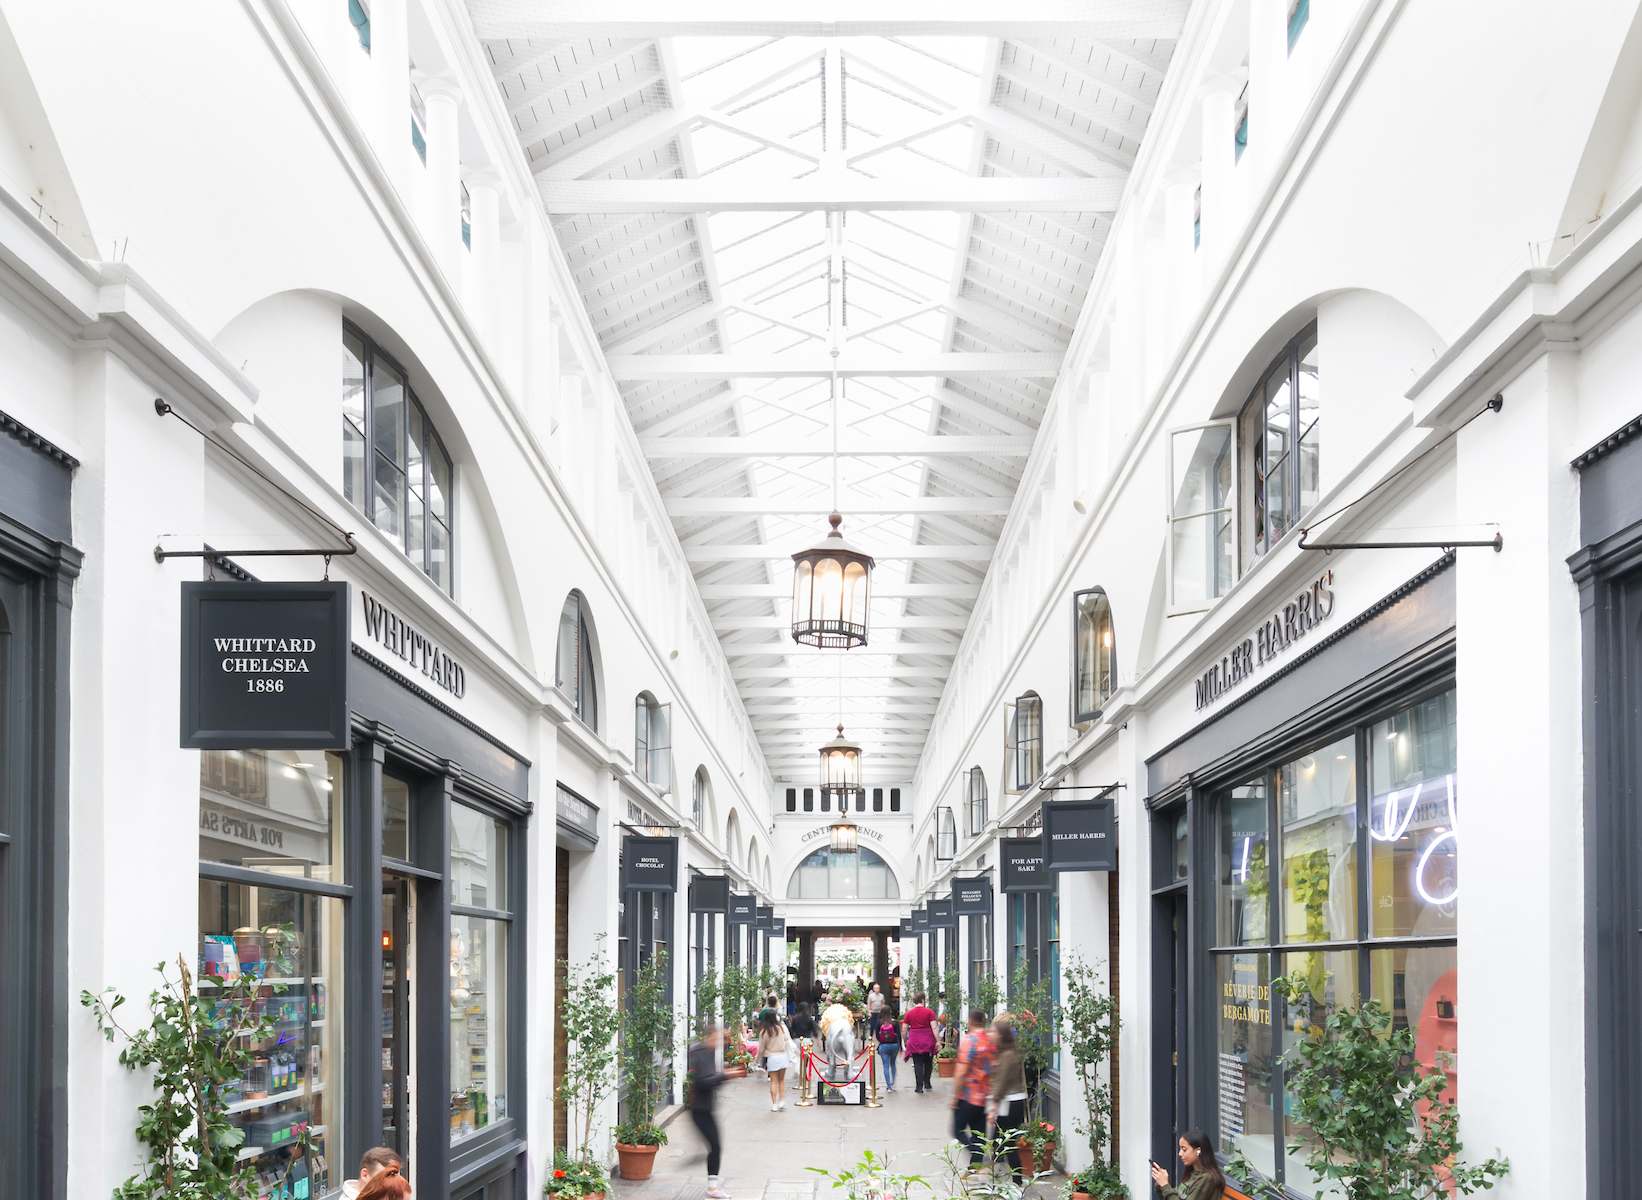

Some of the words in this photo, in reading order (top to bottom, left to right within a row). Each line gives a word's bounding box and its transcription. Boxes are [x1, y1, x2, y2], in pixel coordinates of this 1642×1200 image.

[213, 638, 317, 653] WHITTARD
[362, 590, 466, 699] WHITTARD
[1194, 638, 1253, 712] MILLER
[1255, 570, 1335, 667] HARRIS
[221, 658, 310, 673] CHELSEA
[246, 679, 285, 693] 1886
[801, 826, 831, 843] CENTR
[857, 826, 884, 842] ENUE
[1224, 980, 1256, 1000] RÊVERIE
[1258, 985, 1269, 1001] DE
[1223, 1004, 1270, 1025] BERGAMOTE
